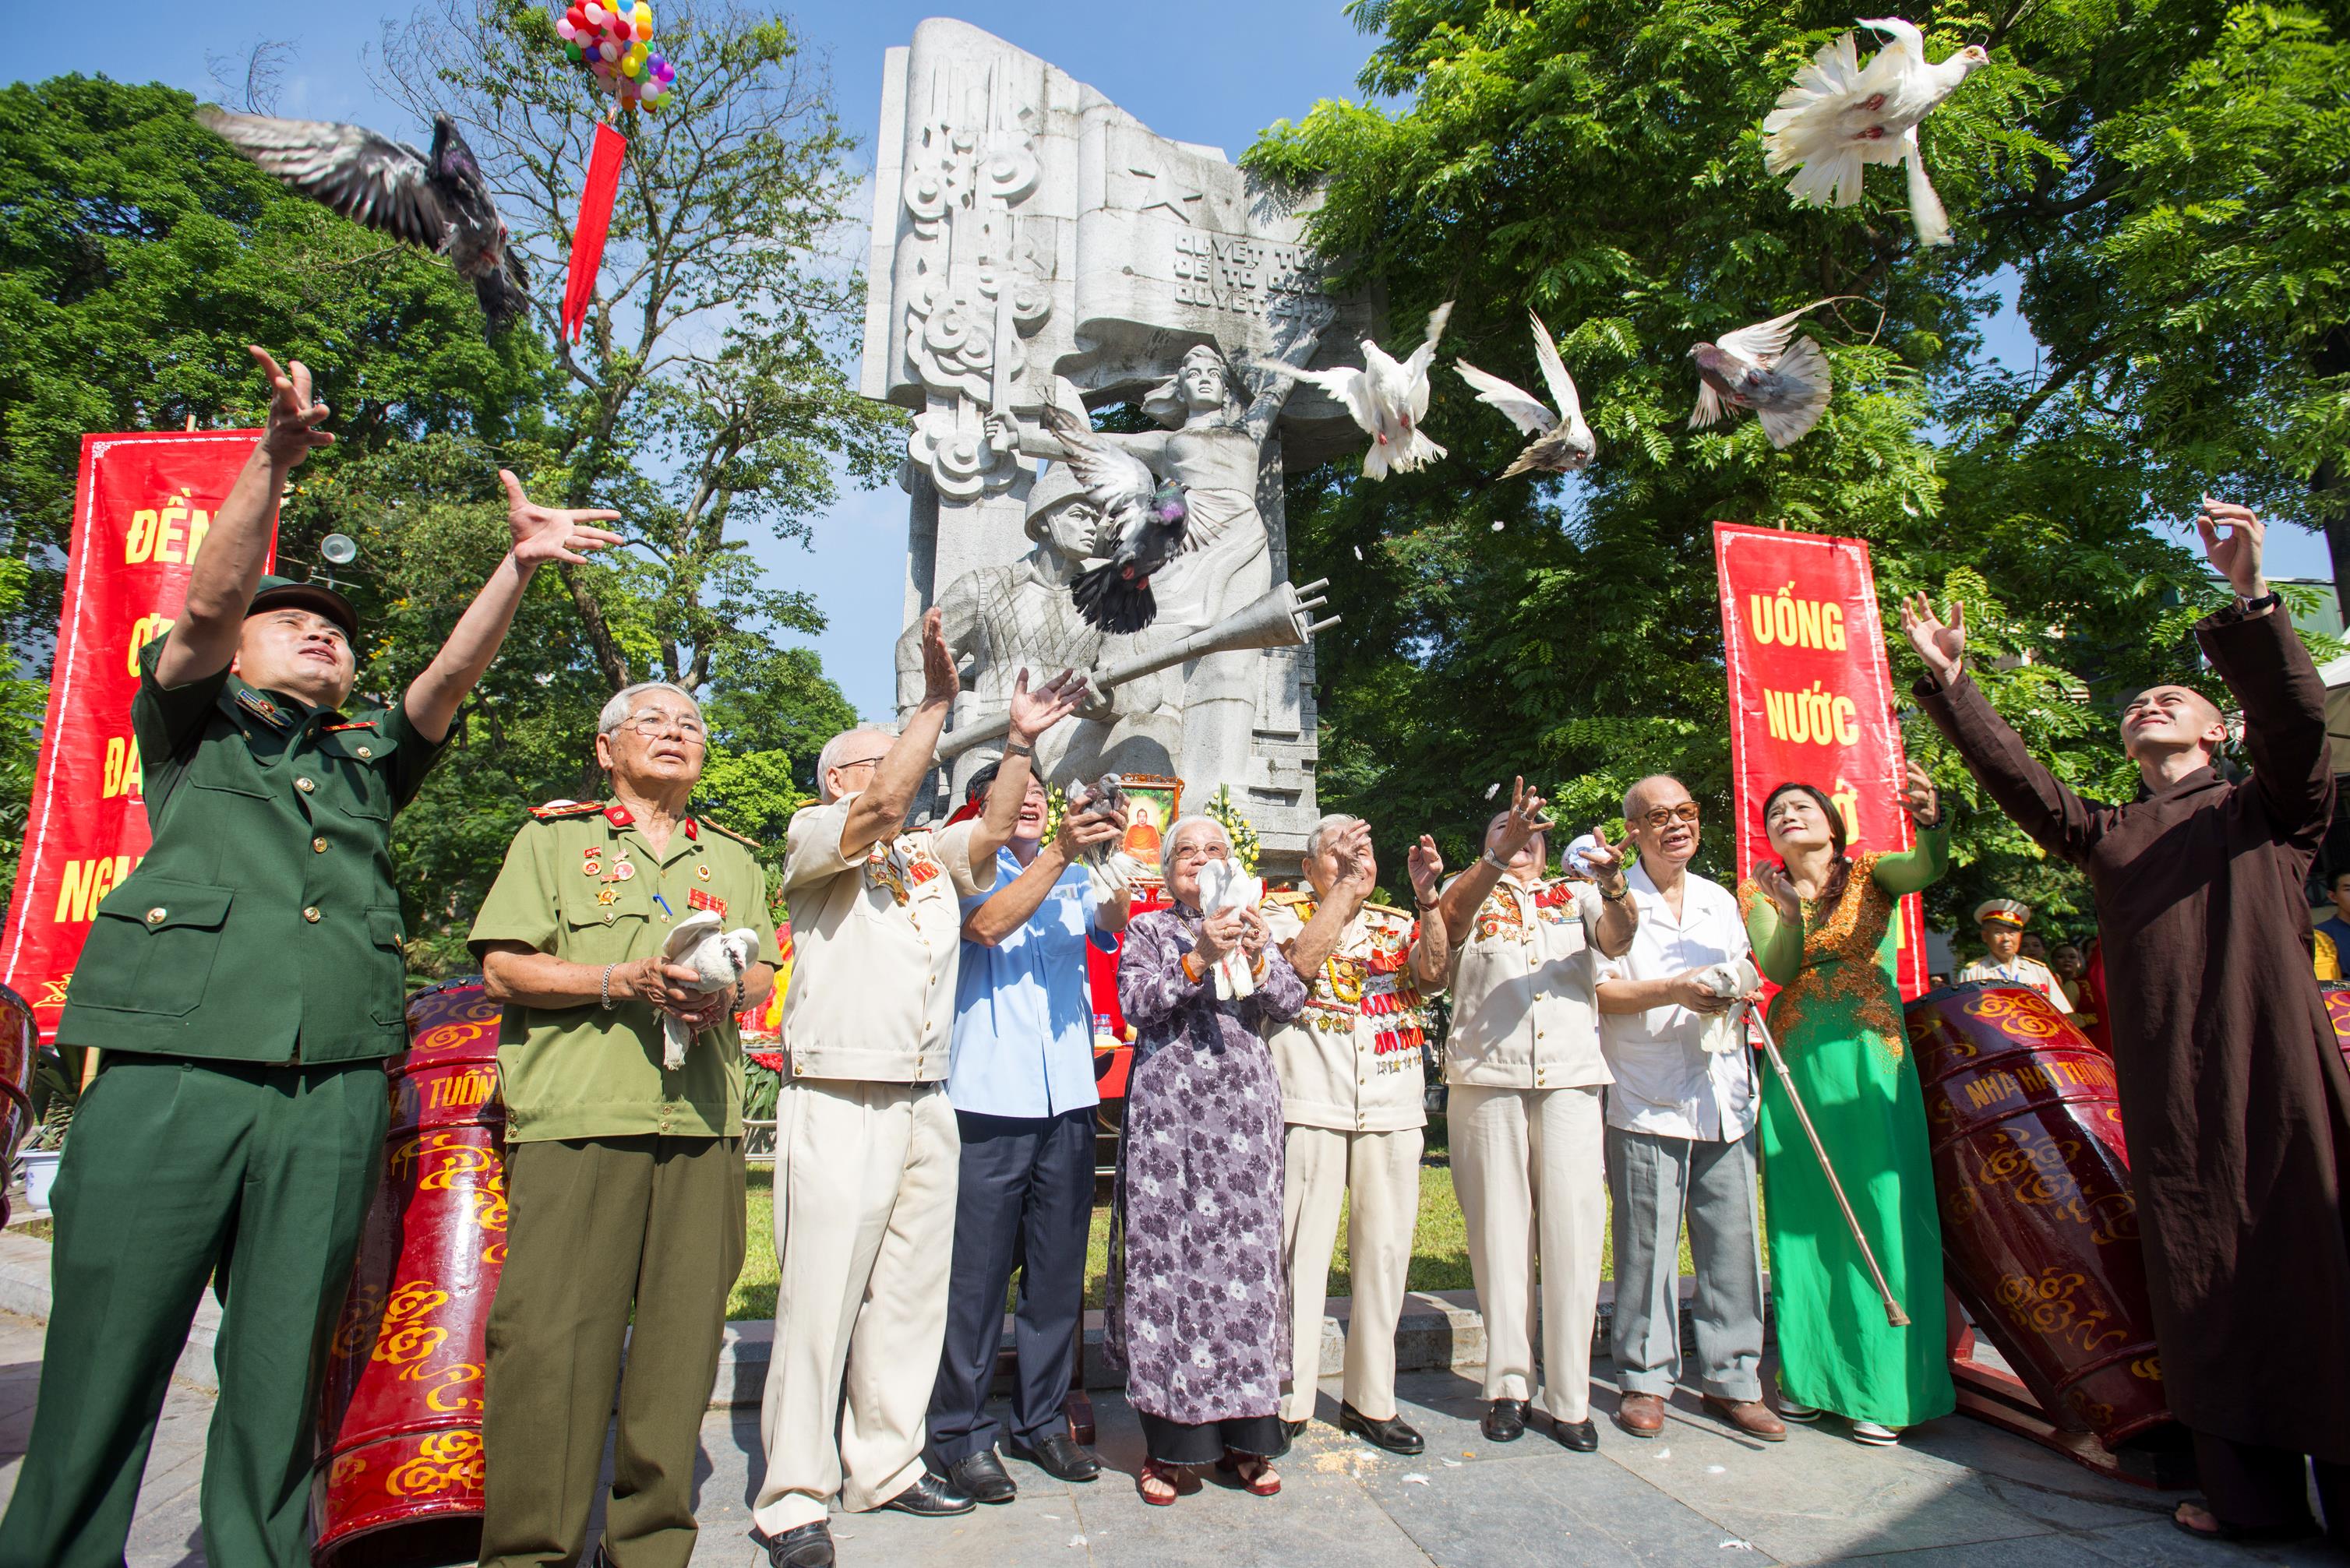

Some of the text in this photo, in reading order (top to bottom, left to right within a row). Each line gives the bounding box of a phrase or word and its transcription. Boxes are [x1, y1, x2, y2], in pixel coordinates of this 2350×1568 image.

[1750, 581, 1847, 651] UỐNG
[1763, 681, 1860, 745] NƯỚC
[1964, 1068, 2024, 1109] NHÀ
